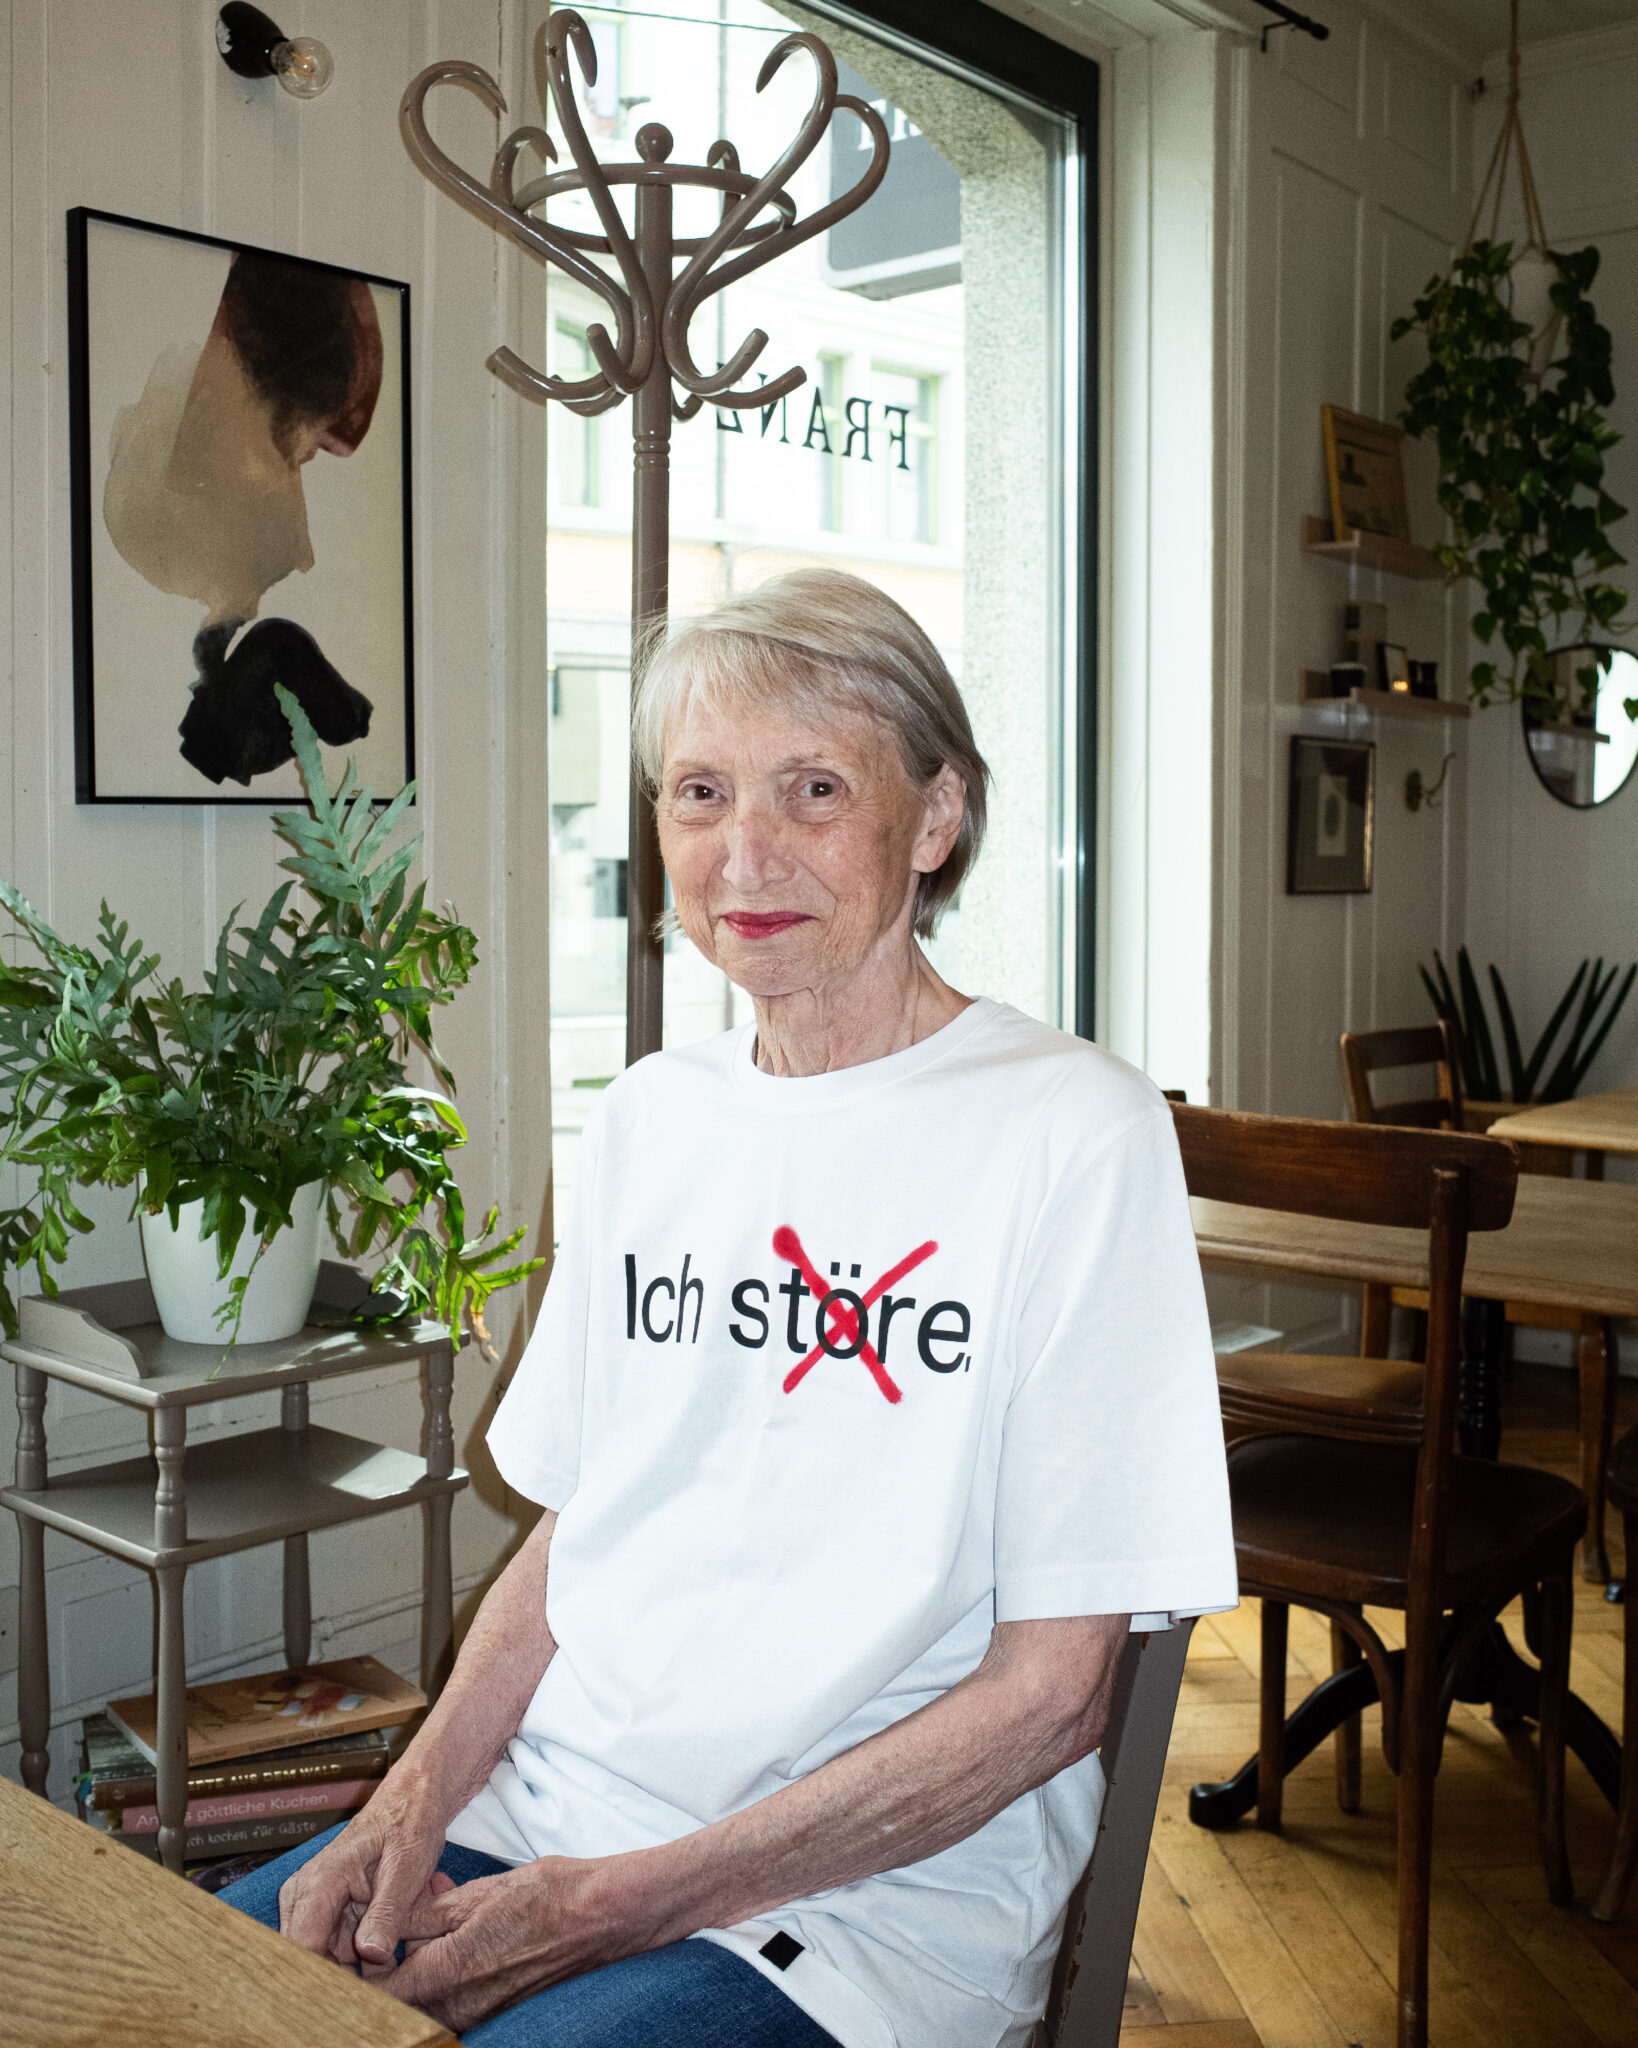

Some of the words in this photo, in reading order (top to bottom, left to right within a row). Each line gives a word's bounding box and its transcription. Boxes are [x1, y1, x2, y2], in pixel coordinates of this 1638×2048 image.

[625, 1254, 704, 1344] Ich
[230, 1773, 258, 1787] AUS
[262, 1768, 297, 1783] DEM
[299, 1763, 341, 1780] WALD
[197, 1800, 265, 1823] göttliche
[270, 1793, 329, 1810] Kuchen
